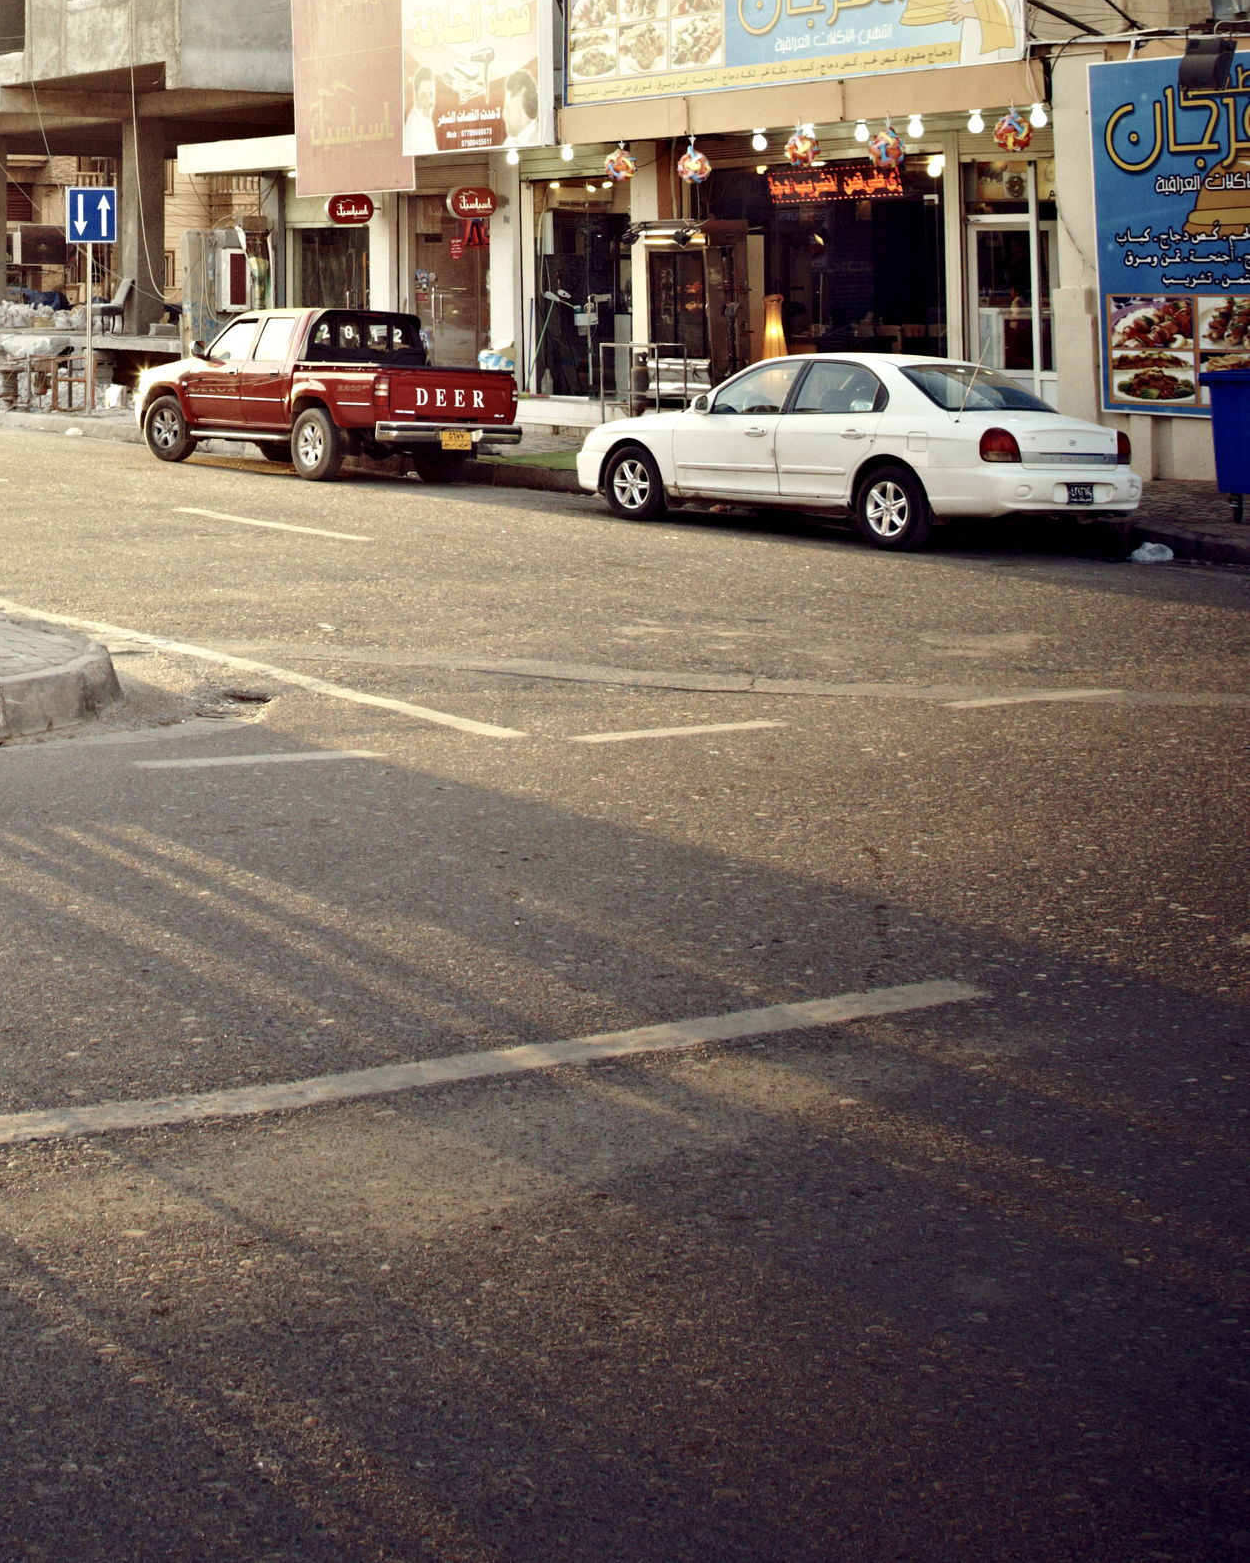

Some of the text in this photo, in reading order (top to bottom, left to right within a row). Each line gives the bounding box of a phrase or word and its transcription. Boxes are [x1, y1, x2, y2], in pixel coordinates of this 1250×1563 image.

[412, 0, 481, 48] الحلاقة
[775, 35, 810, 53] العراقية
[928, 48, 952, 63] دجاج
[1155, 175, 1201, 194] العراقية
[1115, 226, 1151, 247] كباب
[1159, 226, 1188, 249] دجاج
[1124, 250, 1158, 267] ومرق
[1190, 245, 1235, 264] أجنحة
[1162, 272, 1212, 287] تشريب
[416, 388, 485, 408] DEER
